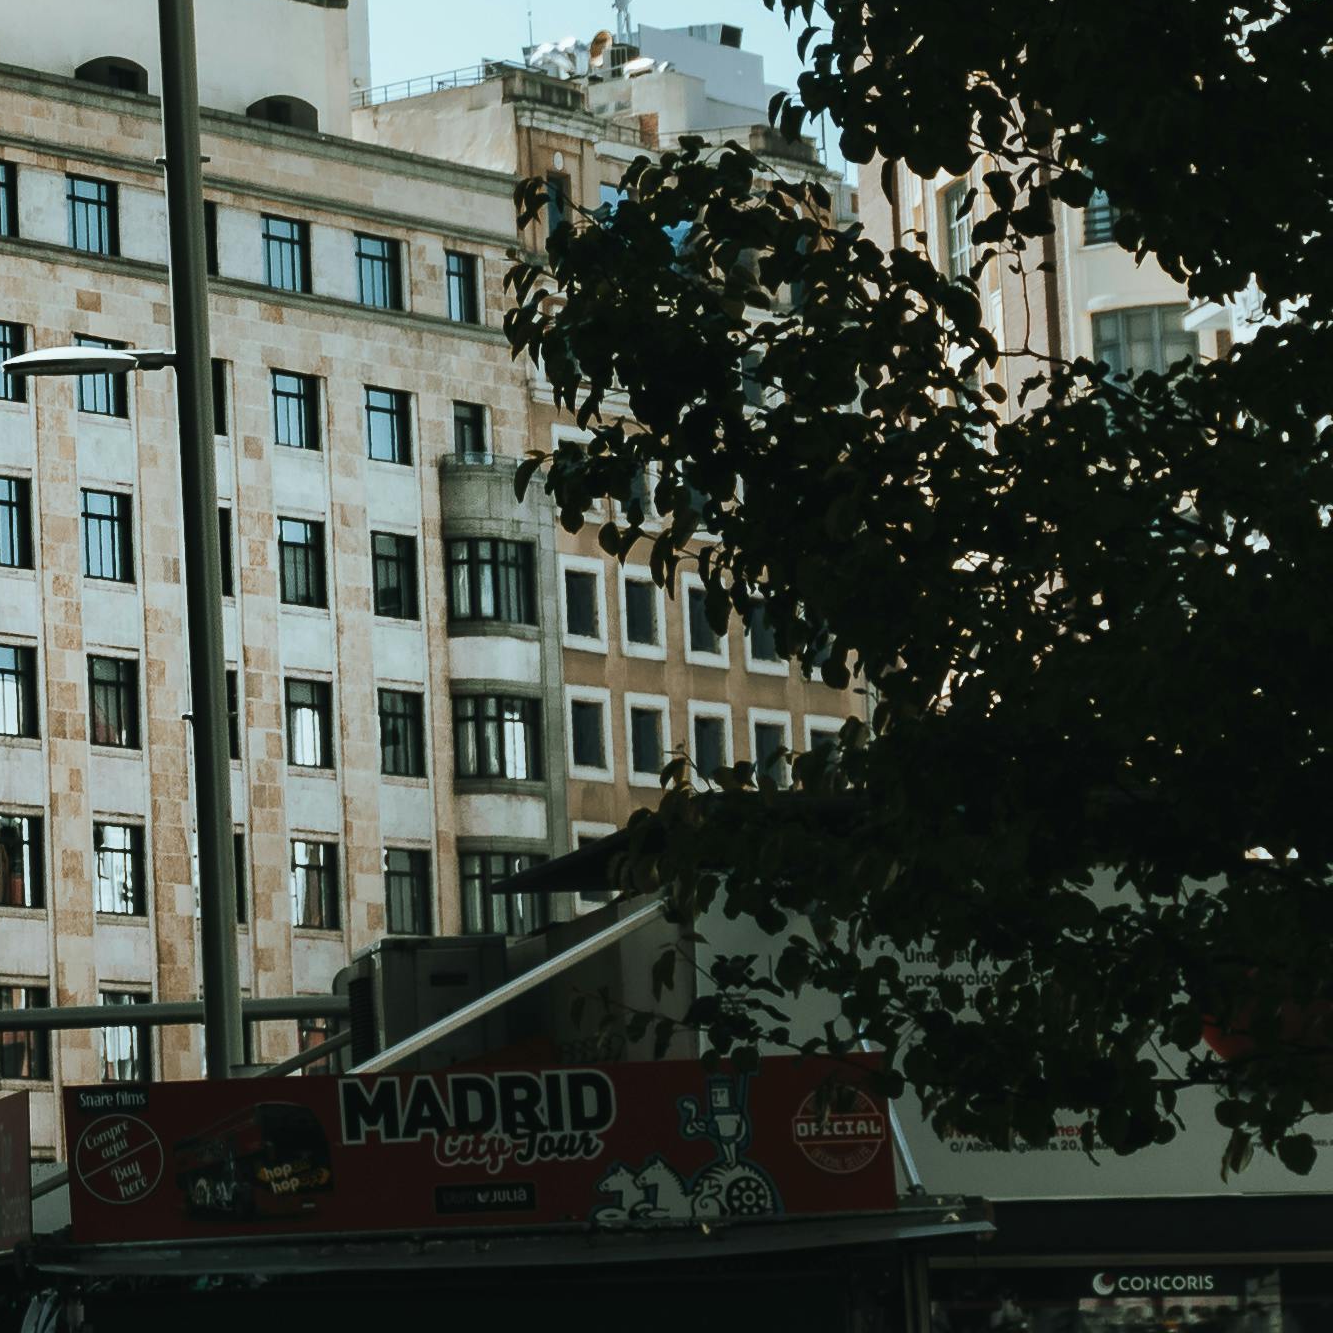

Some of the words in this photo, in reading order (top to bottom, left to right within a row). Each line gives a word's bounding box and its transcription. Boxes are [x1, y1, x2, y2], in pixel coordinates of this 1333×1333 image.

[338, 1069, 616, 1145] MADRID
[85, 1120, 130, 1150] Compre
[434, 1126, 513, 1175] City
[513, 1110, 604, 1166] Tour
[1118, 1274, 1214, 1293] CONCORIS
